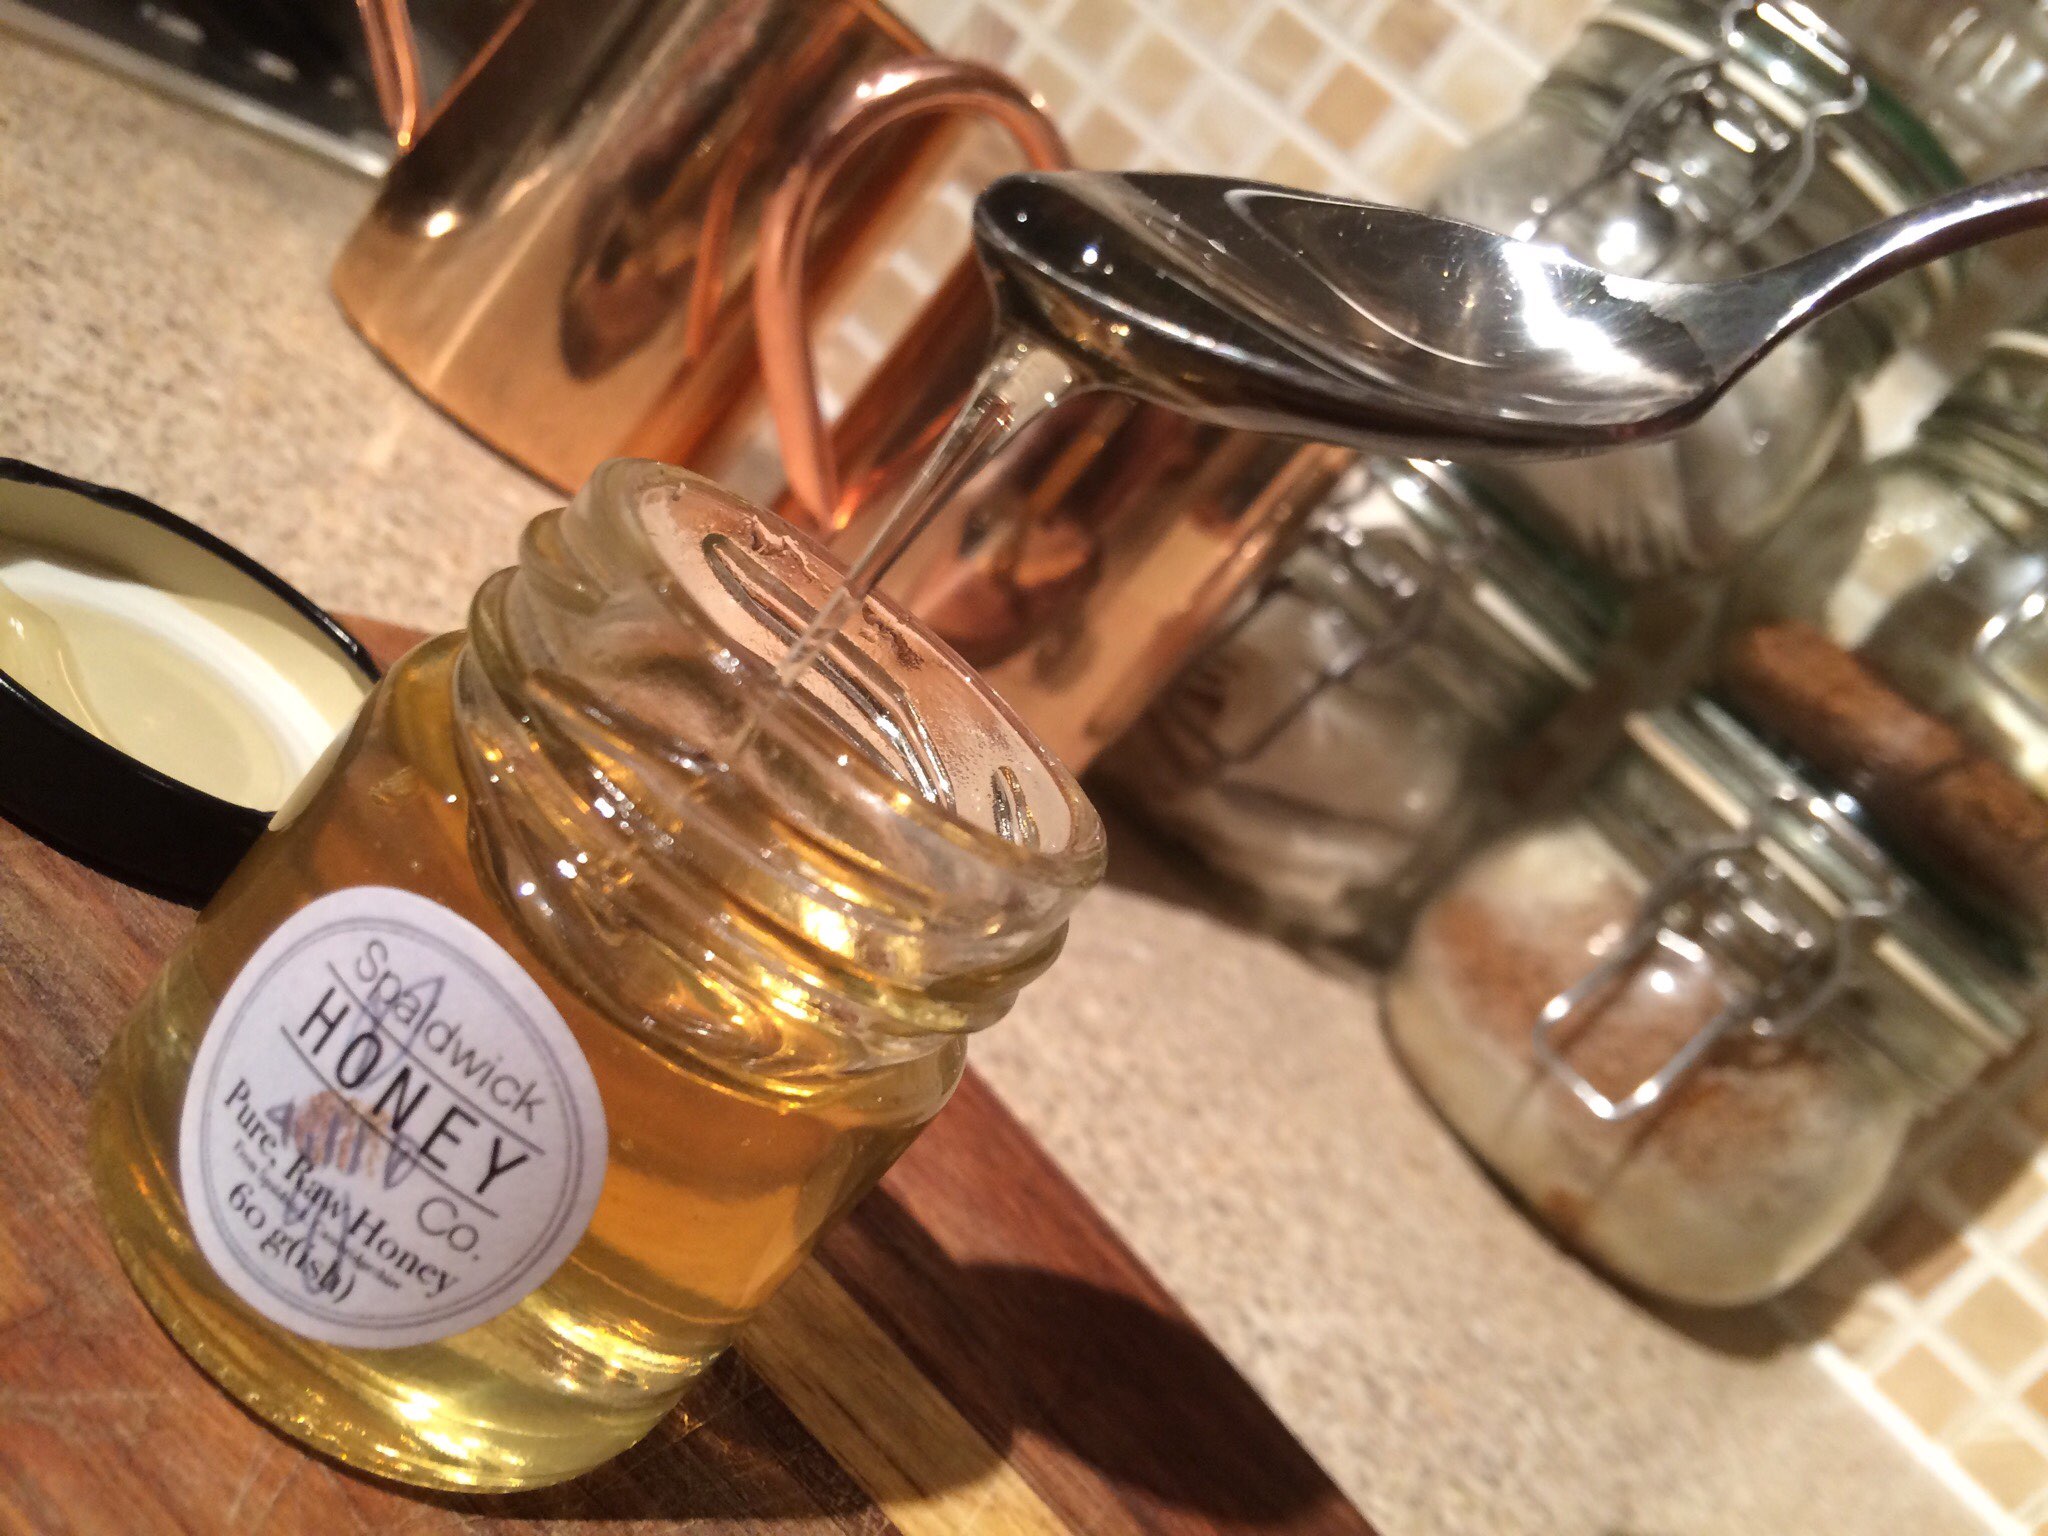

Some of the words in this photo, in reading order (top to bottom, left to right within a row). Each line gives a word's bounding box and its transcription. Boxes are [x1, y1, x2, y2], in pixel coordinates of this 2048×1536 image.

[299, 988, 530, 1194] HONEY
[356, 939, 544, 1123] Spaldwick
[229, 1183, 266, 1229] 60
[285, 1154, 347, 1218] Raw
[349, 1208, 460, 1298] Honey
[417, 1197, 480, 1261] Co.
